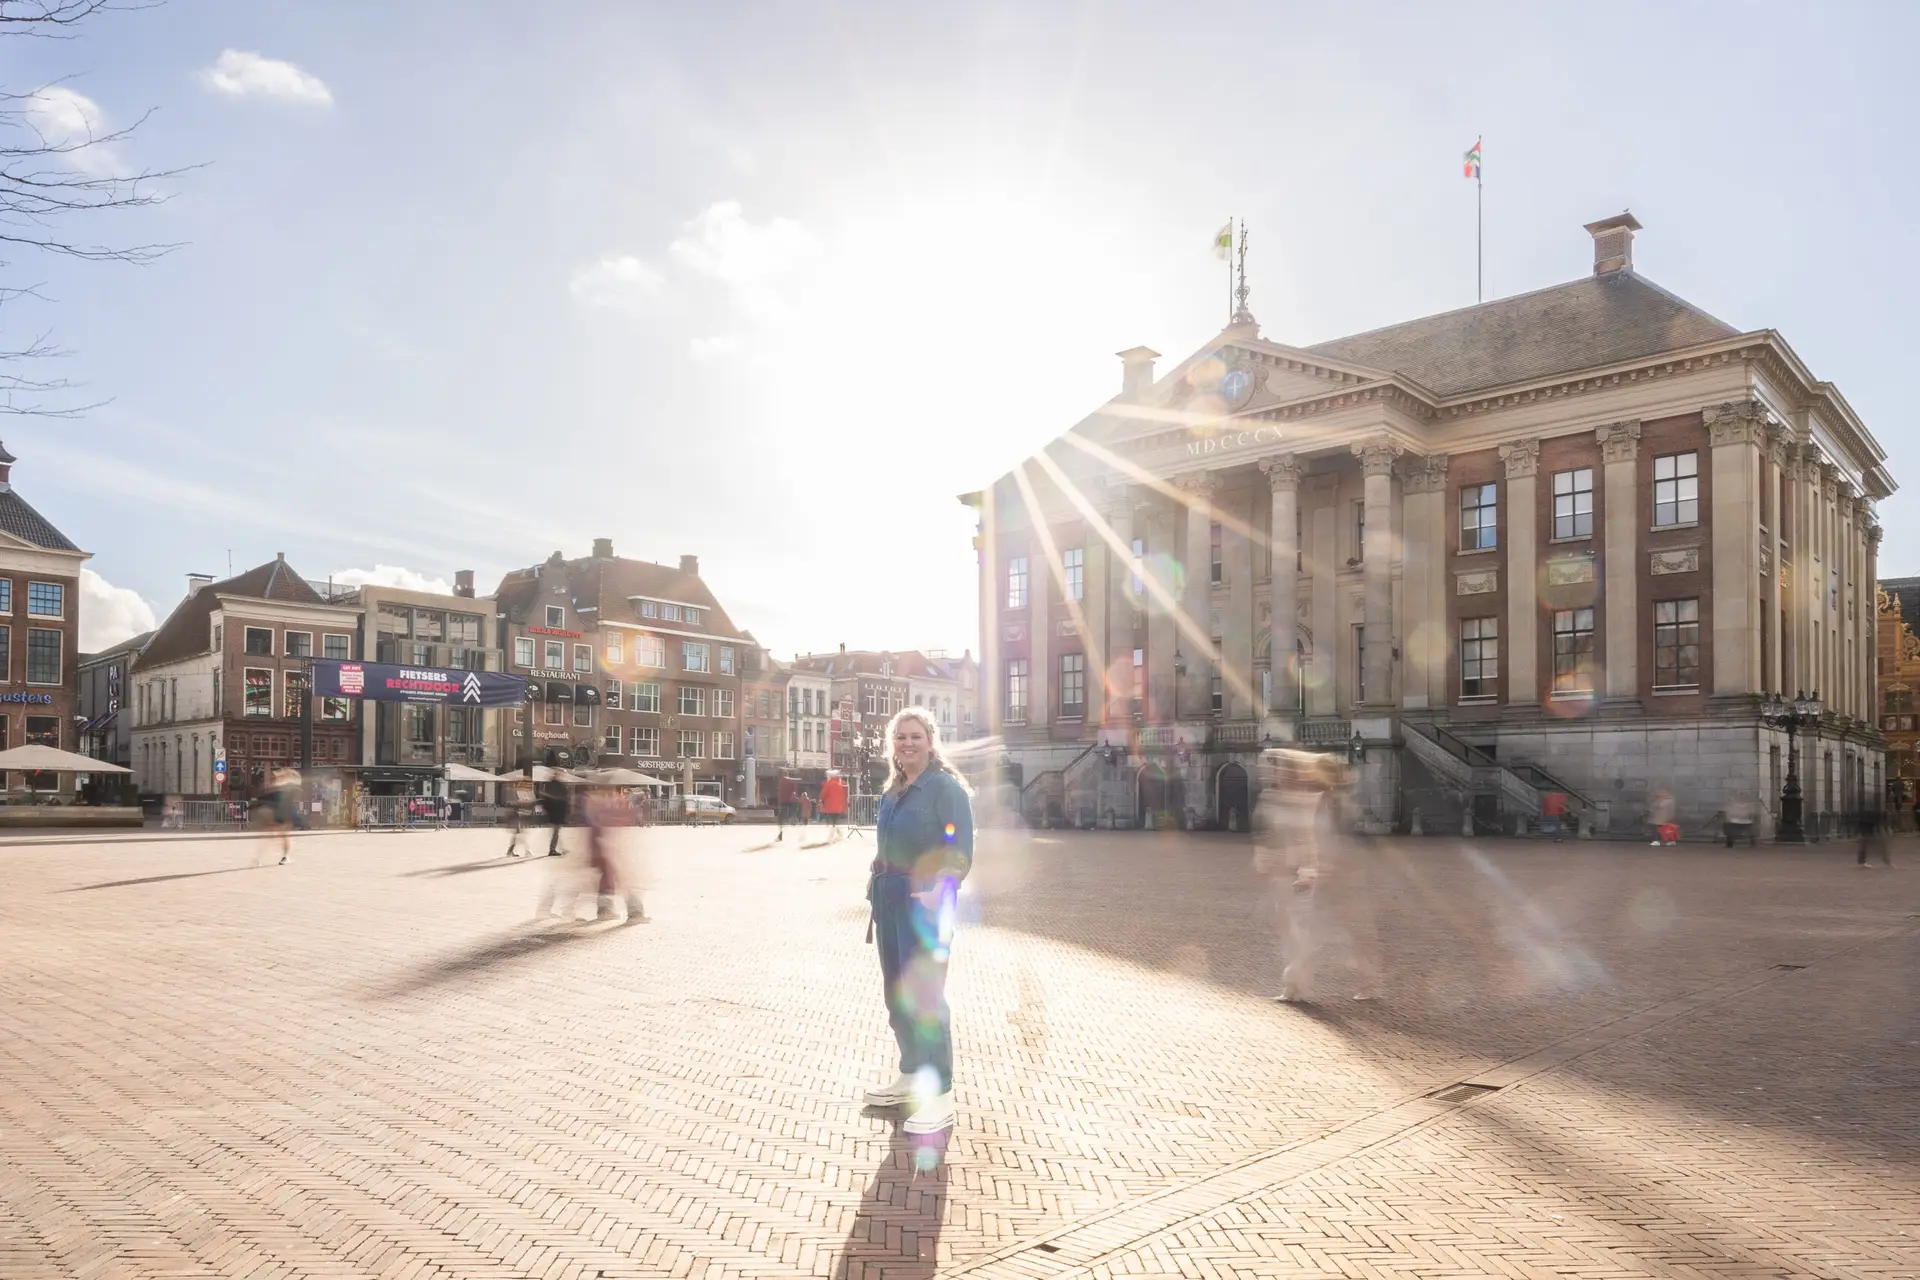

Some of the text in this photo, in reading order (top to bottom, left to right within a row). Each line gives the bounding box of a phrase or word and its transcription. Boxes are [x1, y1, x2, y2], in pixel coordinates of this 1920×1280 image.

[1187, 423, 1284, 457] MDCCCX
[400, 669, 448, 682] FIETSERS
[530, 669, 581, 681] RESTAURANT
[386, 678, 460, 693] RECHTDOOR
[0, 691, 52, 705] usters
[637, 760, 676, 771] SØSTRENE
